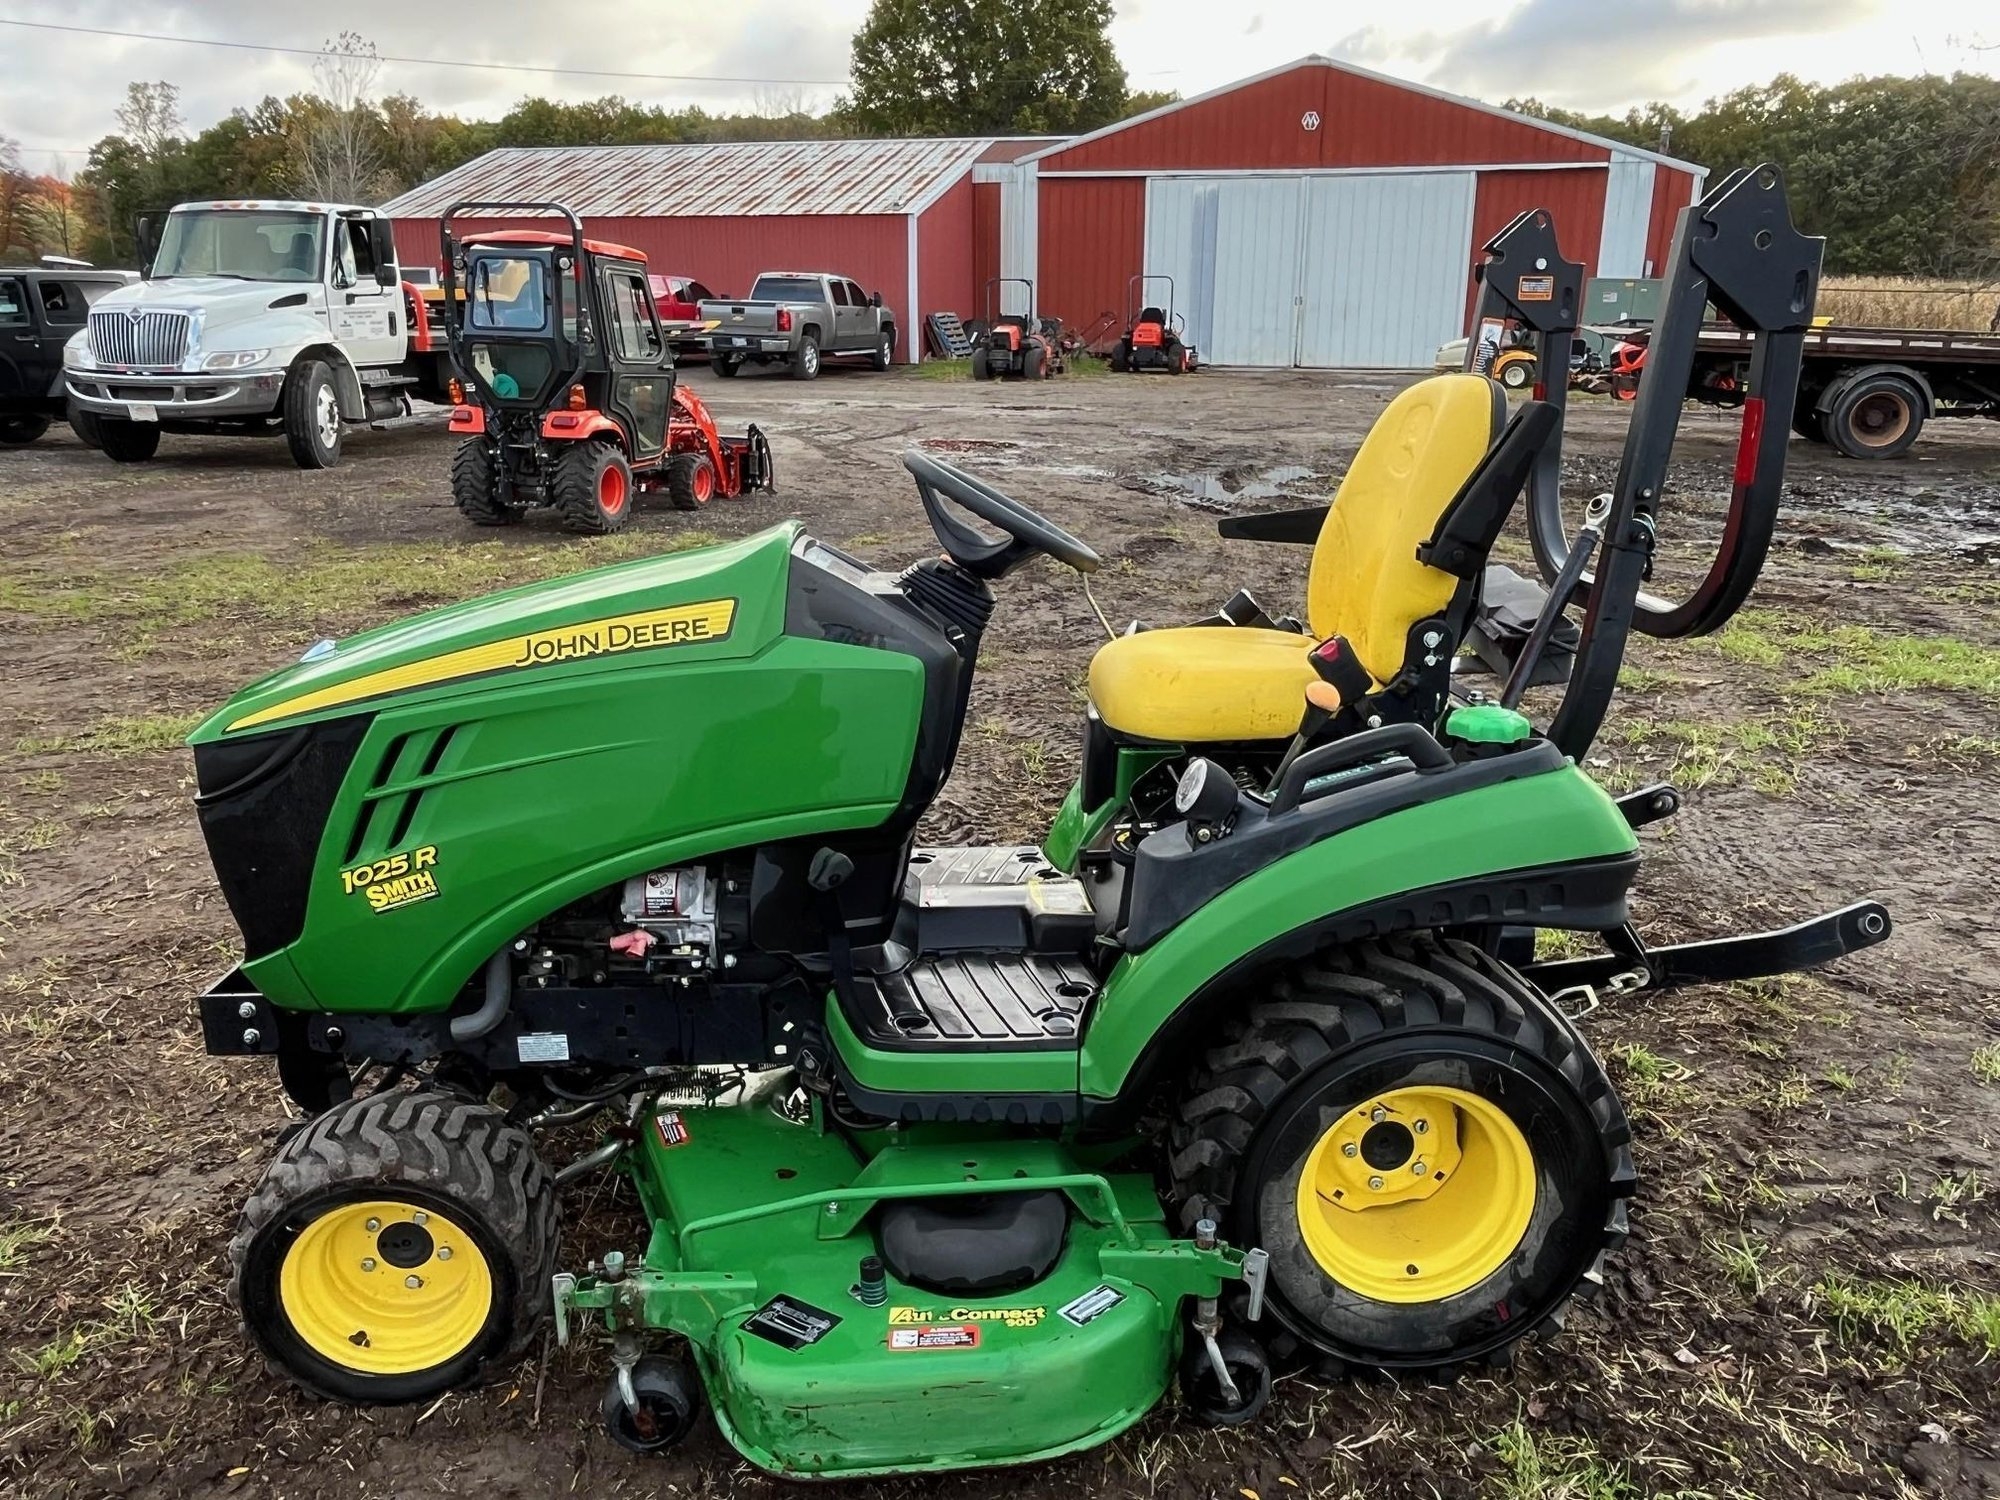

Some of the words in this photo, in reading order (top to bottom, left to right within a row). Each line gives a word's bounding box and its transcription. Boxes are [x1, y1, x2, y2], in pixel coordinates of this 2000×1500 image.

[515, 632, 599, 664] JOHN
[608, 617, 710, 649] DEERE
[341, 853, 409, 894] 1025
[415, 846, 437, 870] R
[365, 870, 435, 908] SMITH
